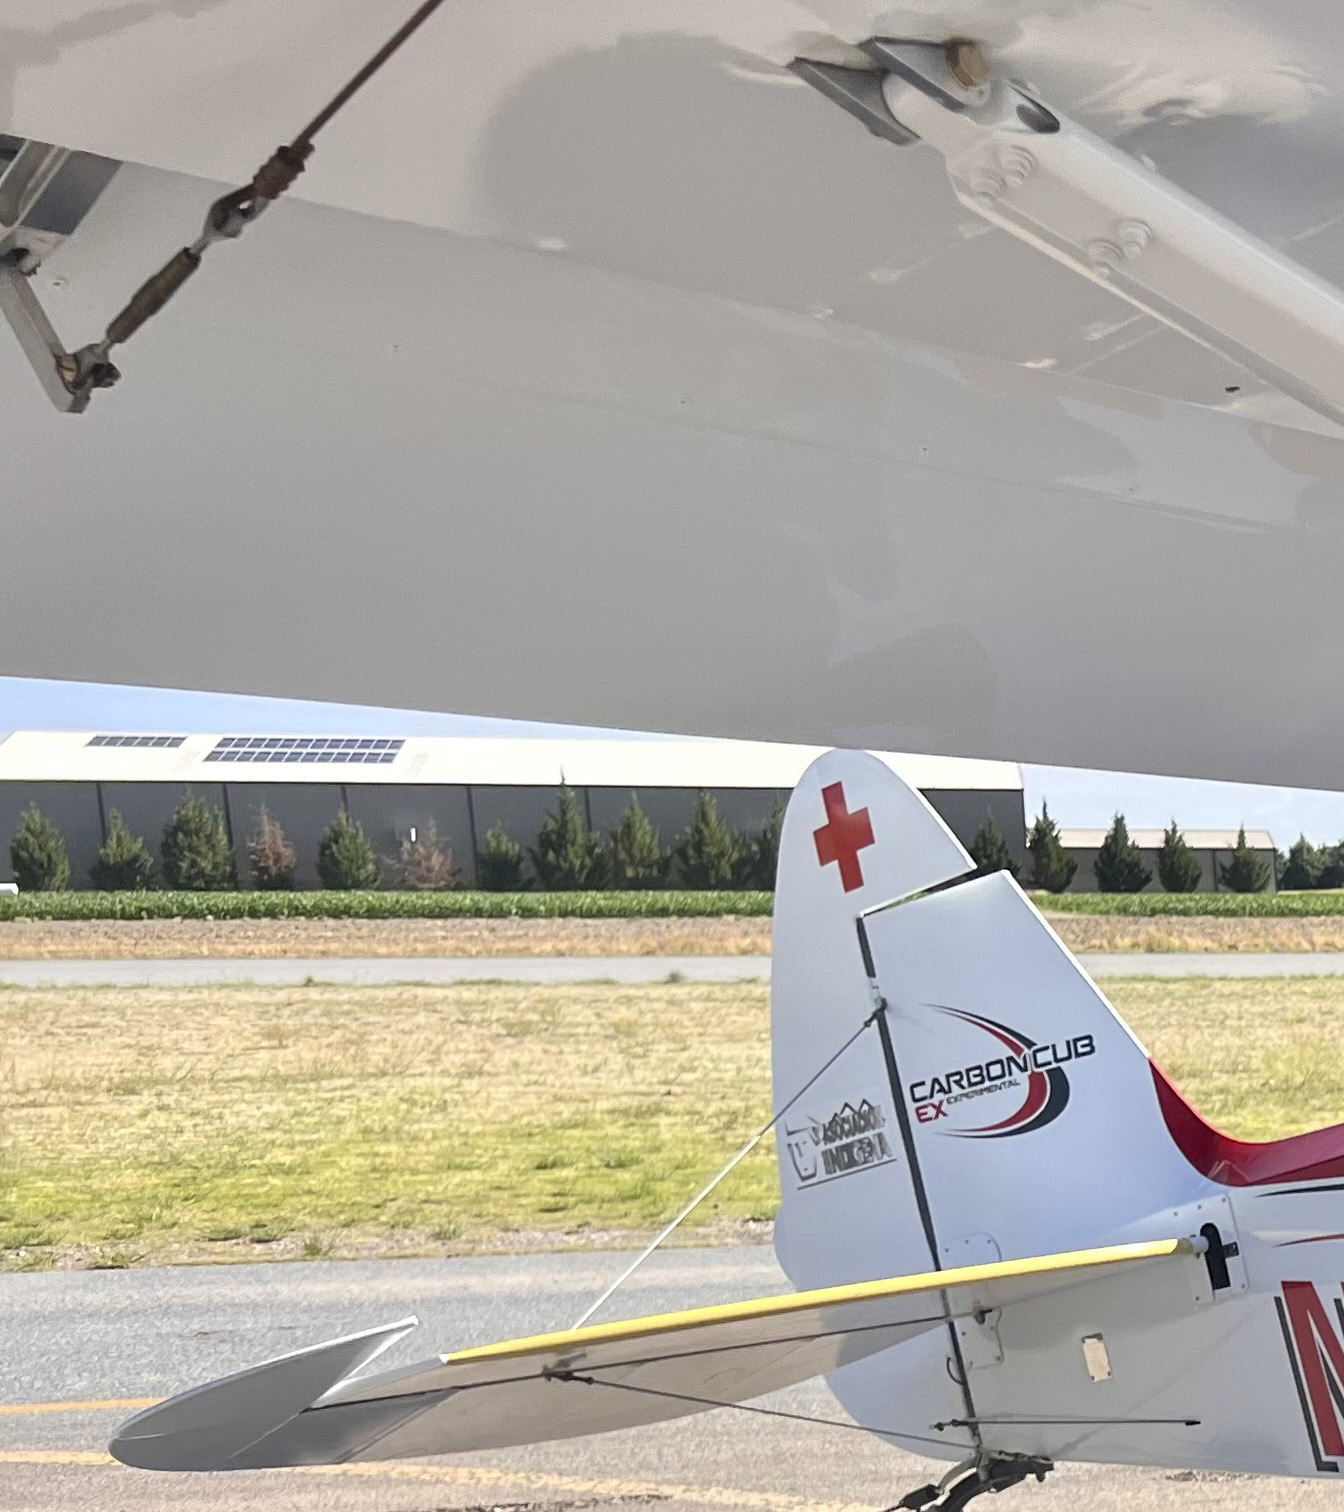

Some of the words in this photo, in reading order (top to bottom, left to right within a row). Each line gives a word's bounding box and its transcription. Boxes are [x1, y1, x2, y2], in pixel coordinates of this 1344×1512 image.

[910, 1054, 1028, 1103] CARBON
[1031, 1034, 1096, 1069] CUB
[947, 1079, 1021, 1105] EXPERIMENTAL
[915, 1101, 948, 1123] EX
